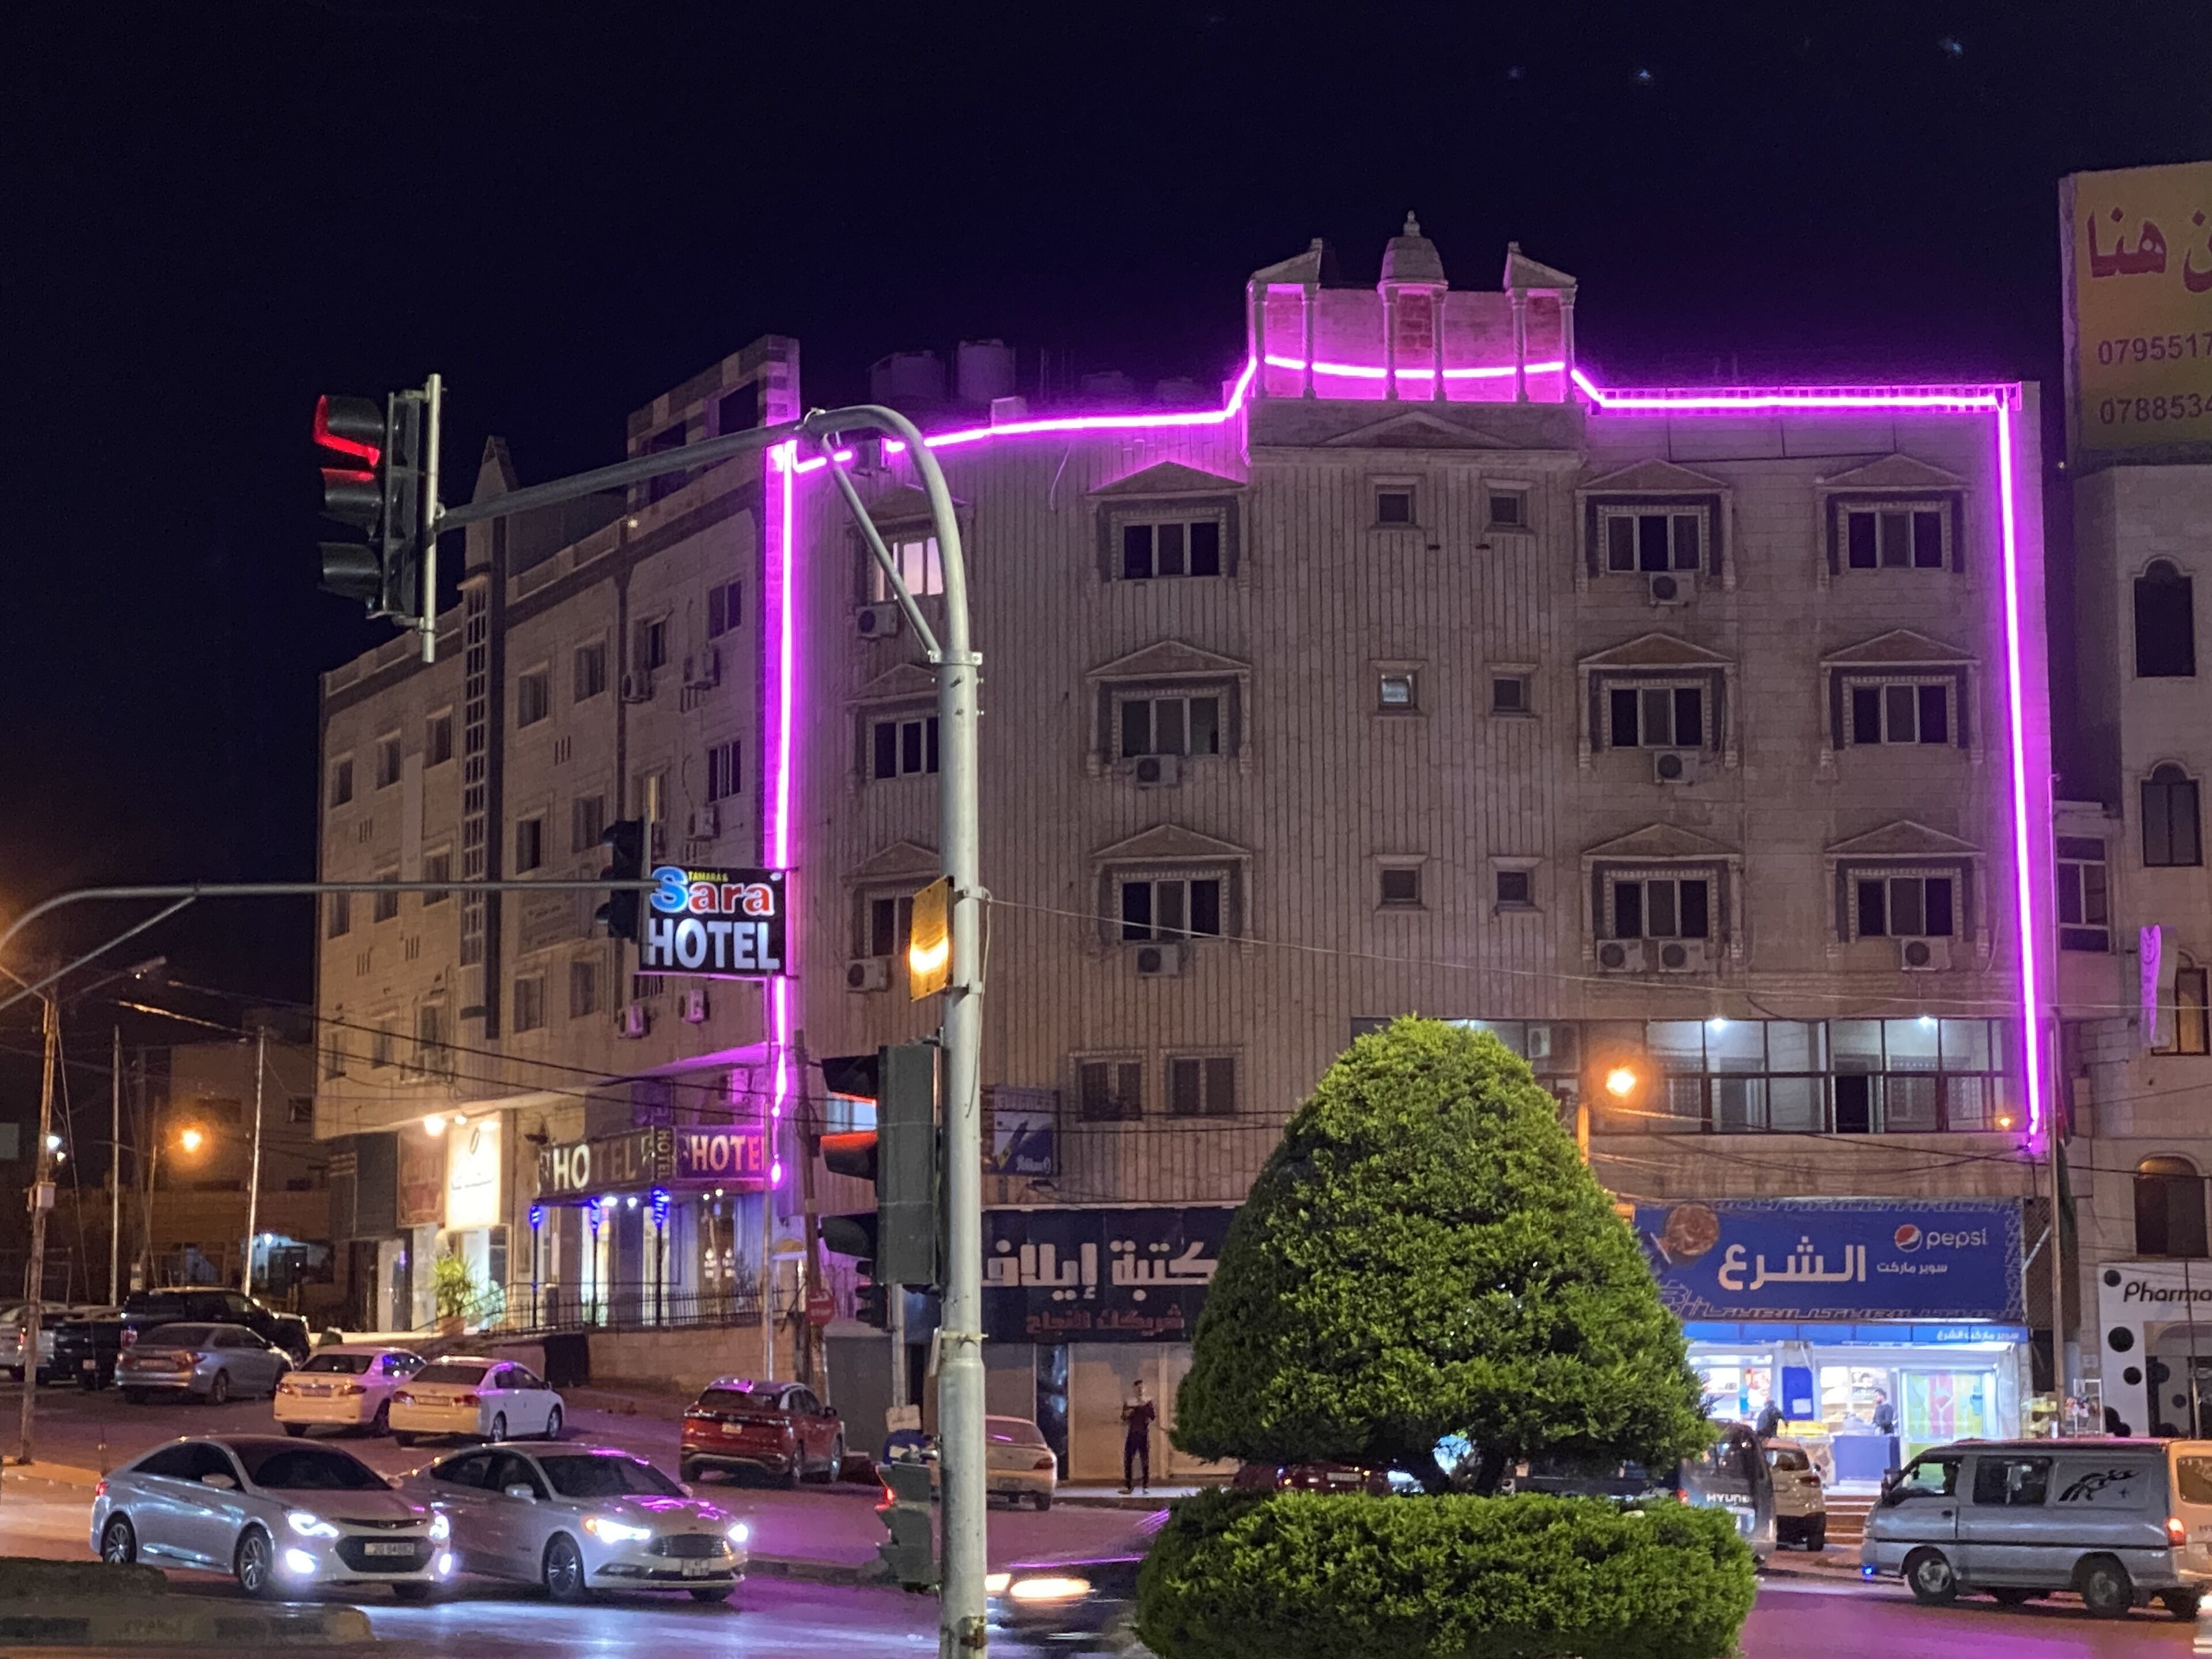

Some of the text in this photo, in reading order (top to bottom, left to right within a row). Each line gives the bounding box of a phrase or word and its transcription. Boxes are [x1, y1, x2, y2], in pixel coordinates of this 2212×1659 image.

[2086, 207, 2166, 278] هنا
[2098, 332, 2212, 365] 0795517
[650, 866, 775, 916] Sara
[648, 918, 781, 969] HOTEL
[553, 1138, 637, 1191] HOTEL
[1717, 1236, 1866, 1290] الشرع
[1926, 1227, 1987, 1249] pepsi
[981, 1240, 1218, 1302] كتبة إيلاف
[1876, 1262, 1948, 1275] سوبر ماركت
[1706, 1493, 1752, 1503] HYUND
